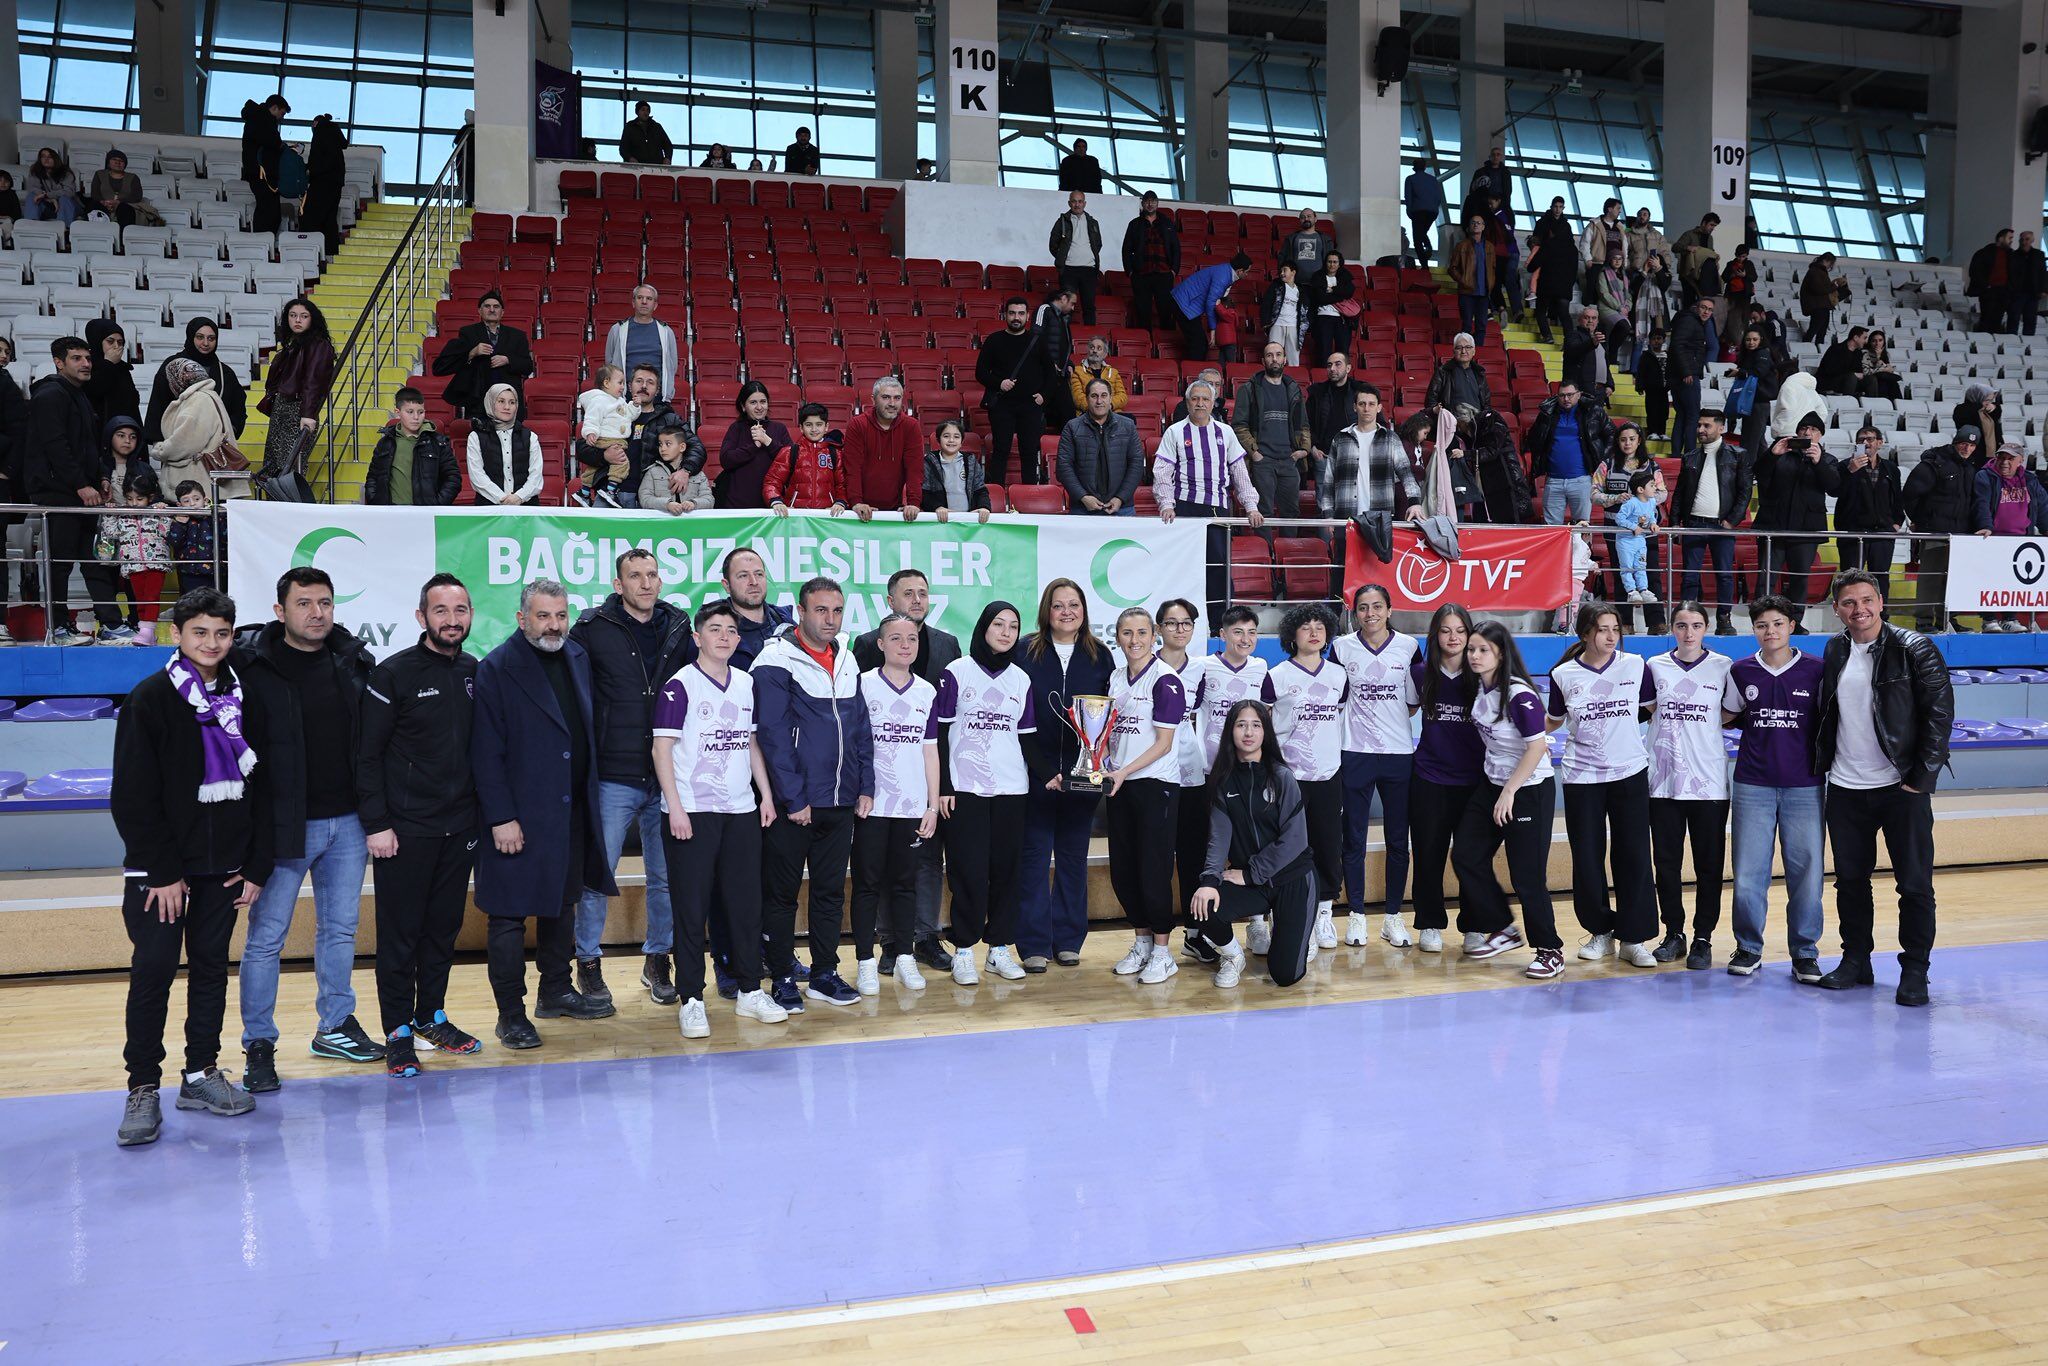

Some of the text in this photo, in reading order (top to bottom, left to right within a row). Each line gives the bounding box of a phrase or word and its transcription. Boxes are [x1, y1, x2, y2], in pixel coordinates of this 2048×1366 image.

[952, 46, 996, 72] 110
[960, 83, 988, 111] K
[1713, 144, 1745, 166] 109
[1721, 178, 1736, 201] J
[488, 531, 737, 585] BAĞISIZ
[1458, 559, 1526, 591] TVF
[1980, 590, 2048, 607] KADINLA
[1579, 708, 1631, 722] MUSTAFA
[1753, 719, 1800, 729] MUSTAFA
